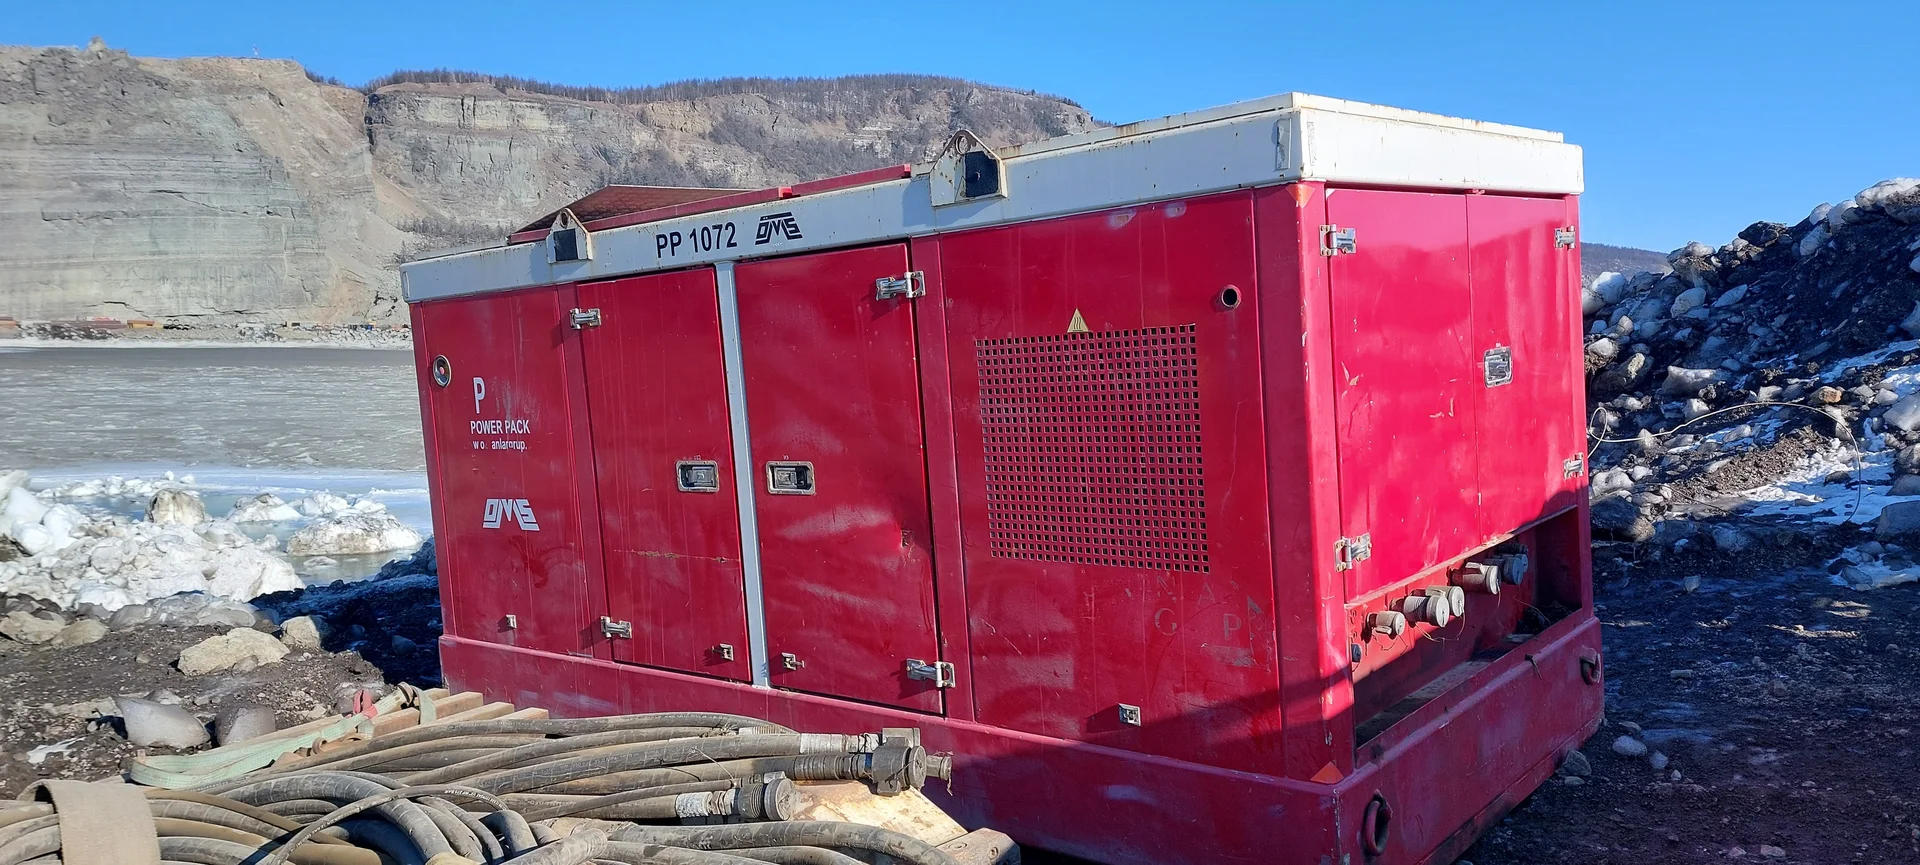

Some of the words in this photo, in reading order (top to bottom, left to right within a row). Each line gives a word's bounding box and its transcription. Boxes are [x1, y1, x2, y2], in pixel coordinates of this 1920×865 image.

[656, 231, 682, 258] PP
[689, 221, 738, 253] 1072
[470, 420, 503, 435] POWER
[504, 419, 531, 434] PACK
